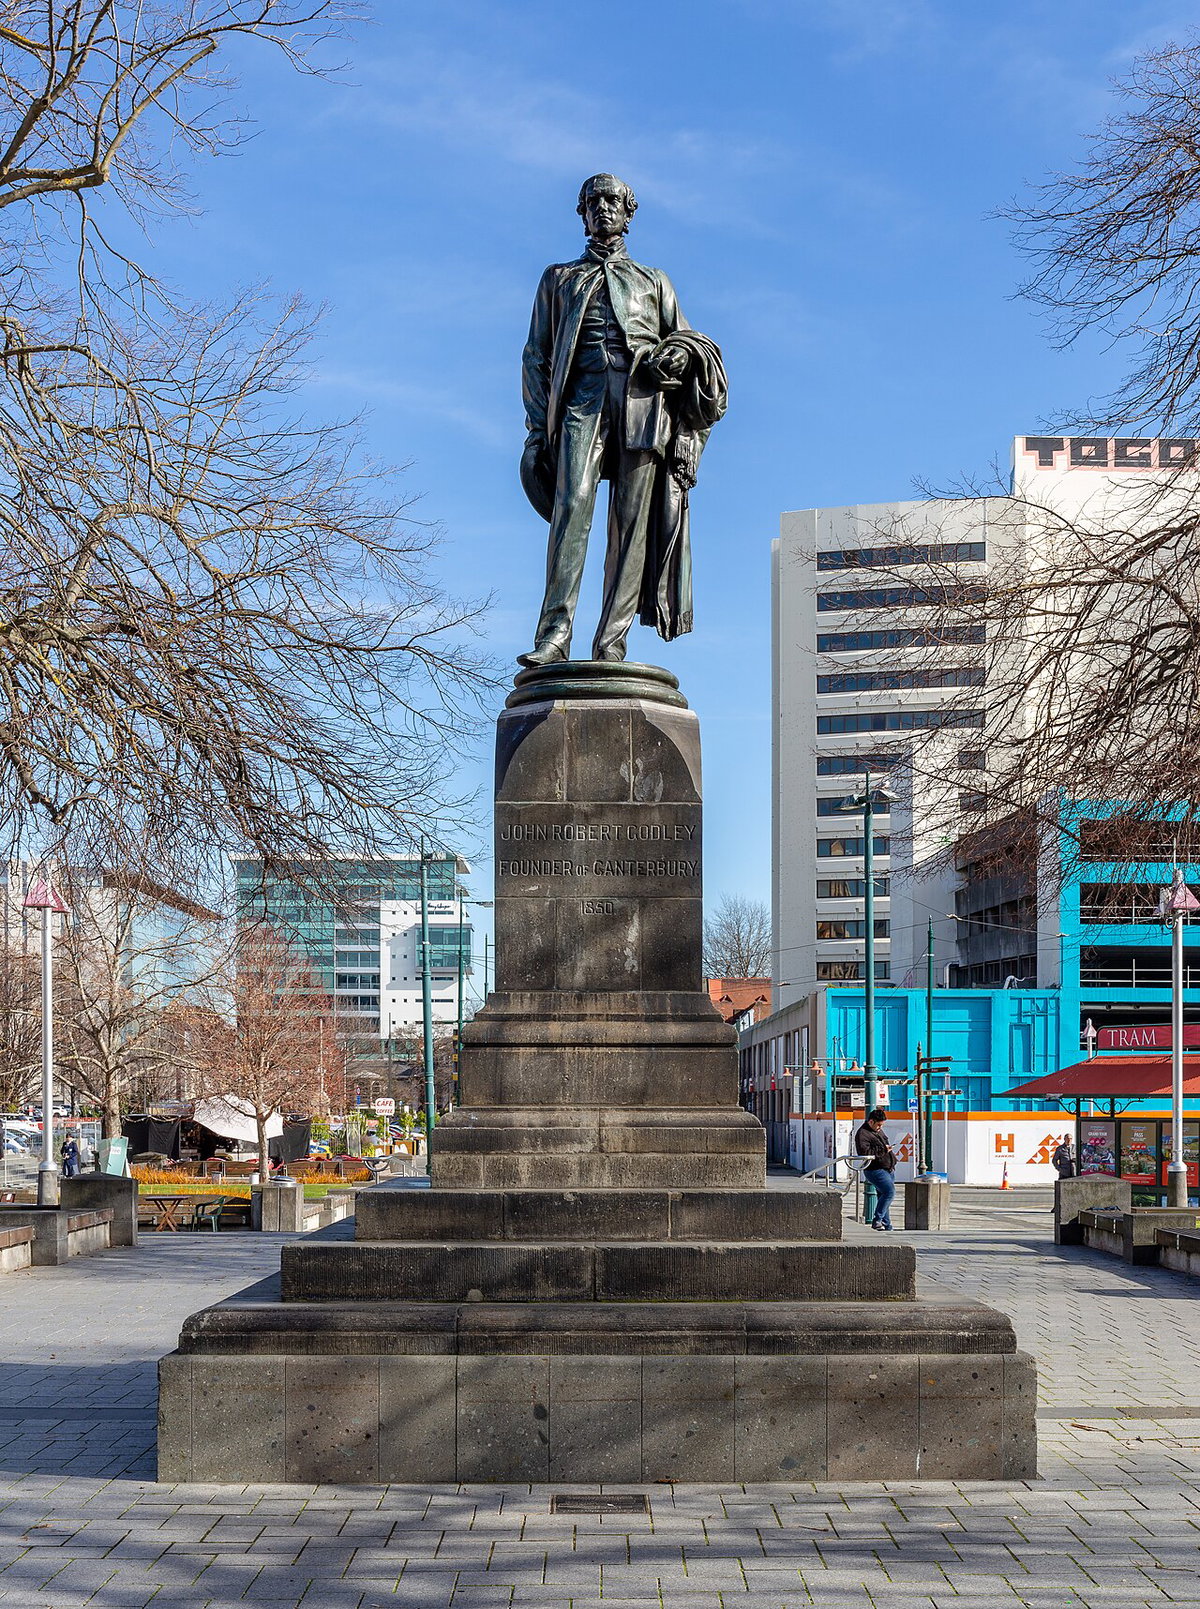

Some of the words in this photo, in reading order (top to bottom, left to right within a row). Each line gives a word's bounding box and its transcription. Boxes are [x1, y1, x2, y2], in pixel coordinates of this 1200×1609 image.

[501, 824, 547, 841] JOHN
[552, 824, 622, 841] ROBERT
[626, 824, 696, 841] GODLEY
[499, 860, 573, 877] FOUNDER
[1107, 1029, 1156, 1046] TRAM
[995, 1133, 1014, 1153] H
